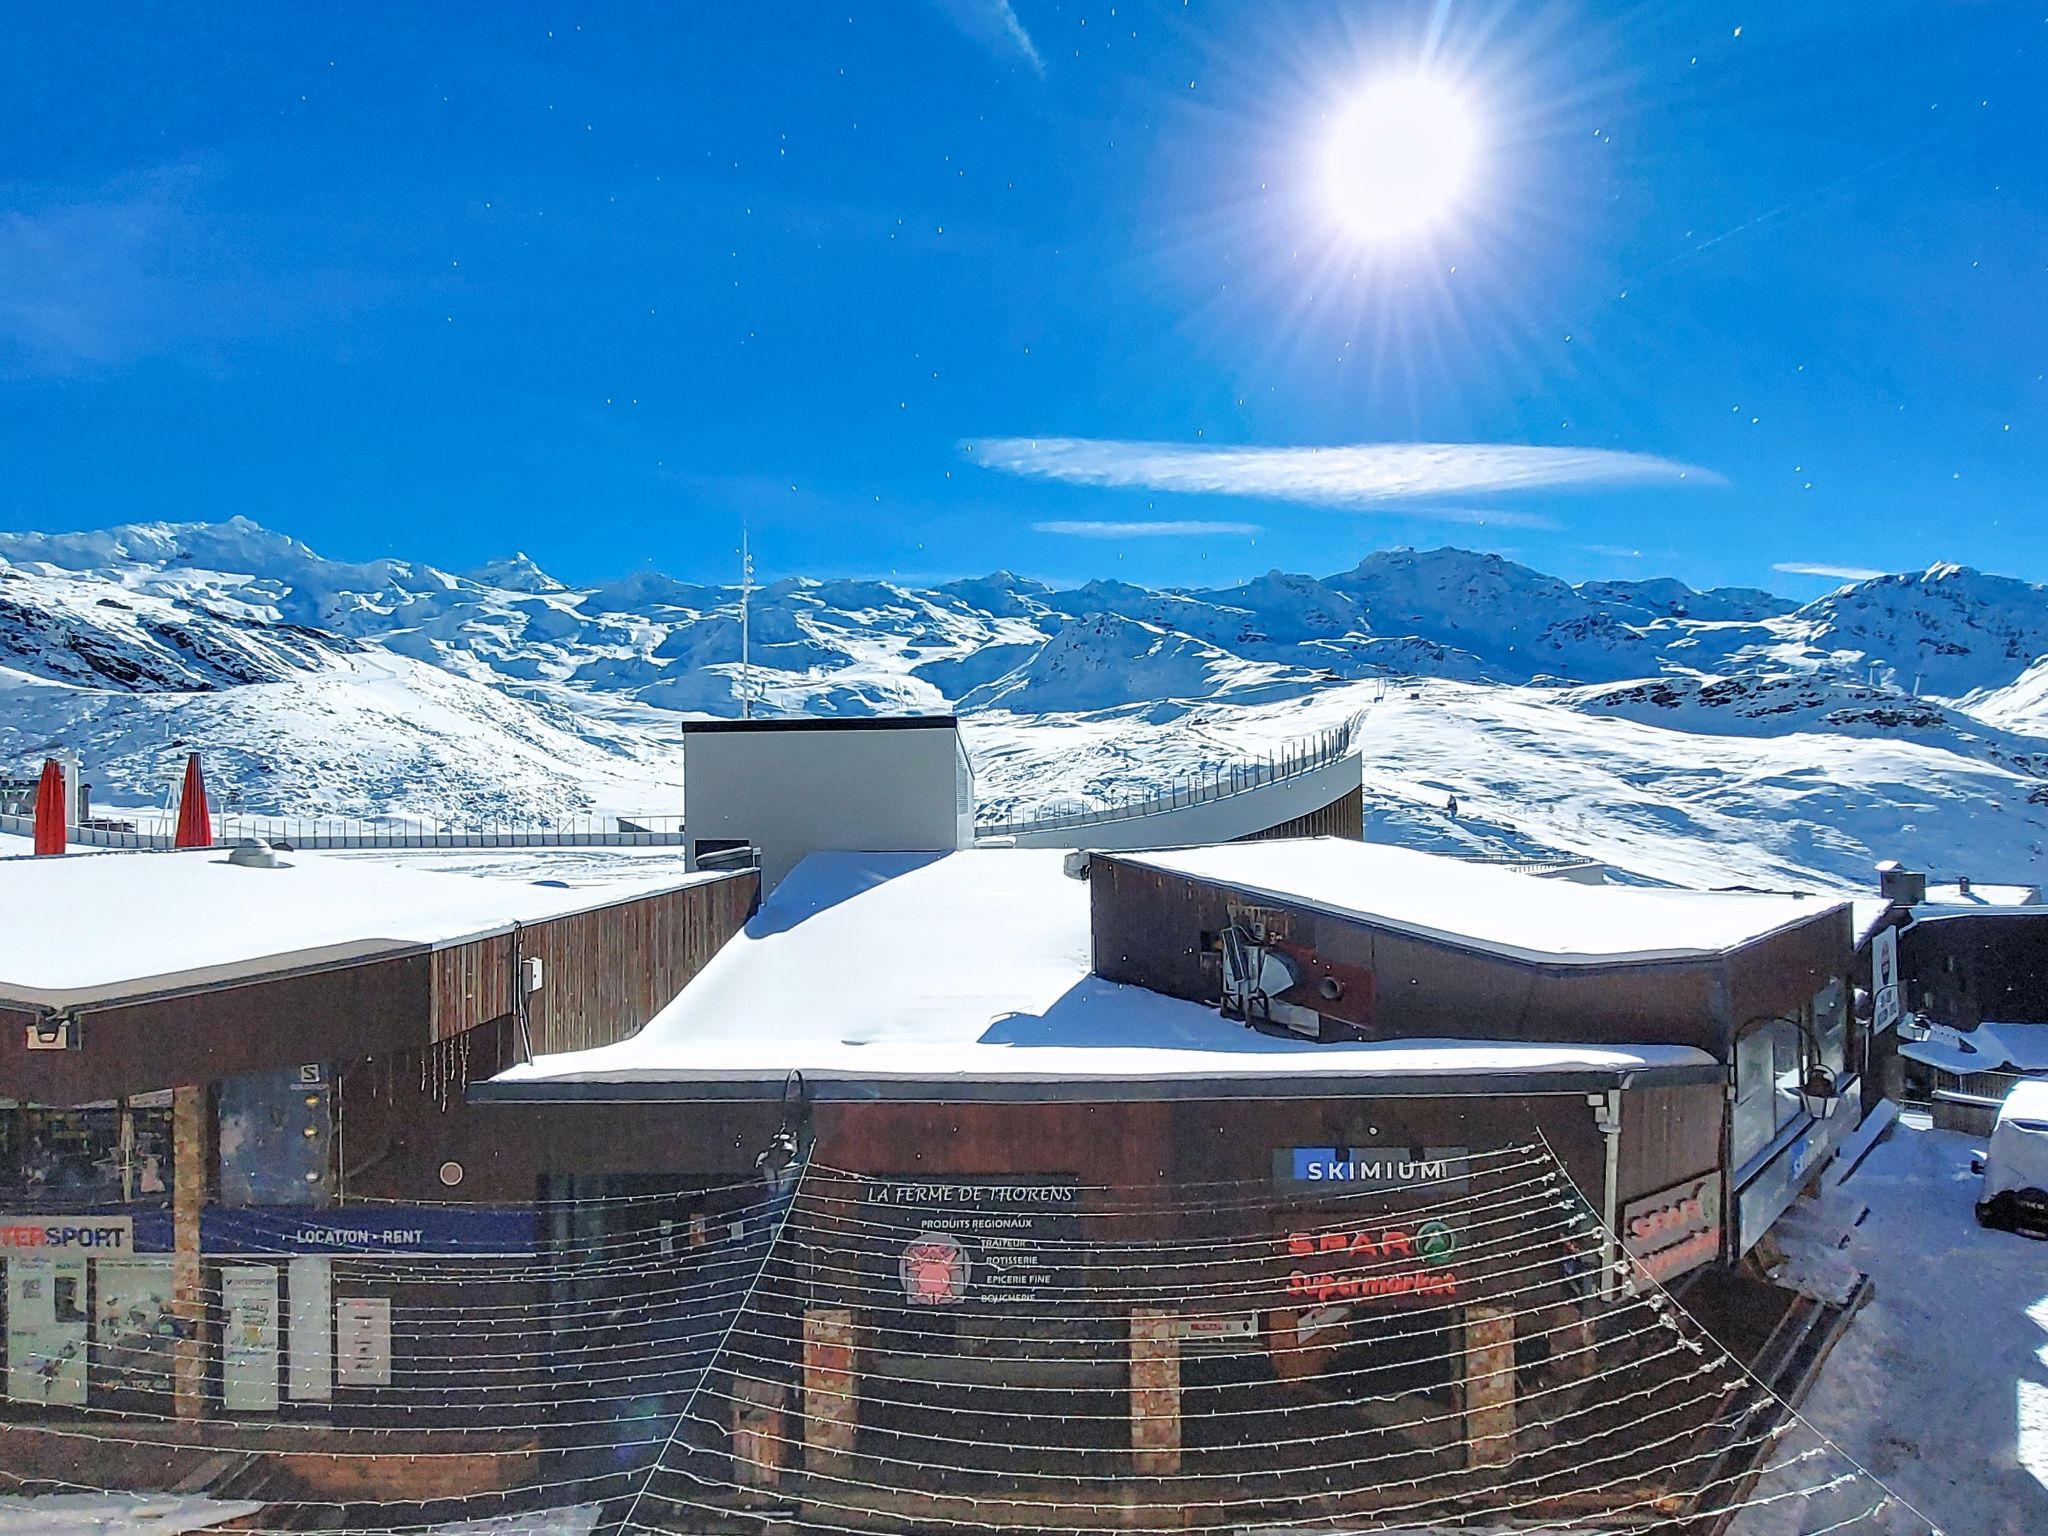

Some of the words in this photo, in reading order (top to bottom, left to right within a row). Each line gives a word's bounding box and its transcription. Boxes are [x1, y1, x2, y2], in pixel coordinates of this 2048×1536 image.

[1307, 1161, 1443, 1181] SKIMIUM
[867, 1187, 889, 1202] LA
[896, 1187, 953, 1203] FERME
[957, 1187, 982, 1201] DE
[990, 1187, 1072, 1202] THORENS
[921, 1219, 970, 1229] PRODUITS
[972, 1219, 1032, 1229] REGIONAUX
[296, 1229, 368, 1244] LOCATION
[383, 1229, 423, 1244] RENT
[981, 1239, 1026, 1248] TRAITEUR
[1288, 1231, 1411, 1257] SPAR
[986, 1256, 1039, 1266] ROTISSERIE
[986, 1275, 1026, 1284] EPICERIE
[1029, 1274, 1052, 1284] FINE
